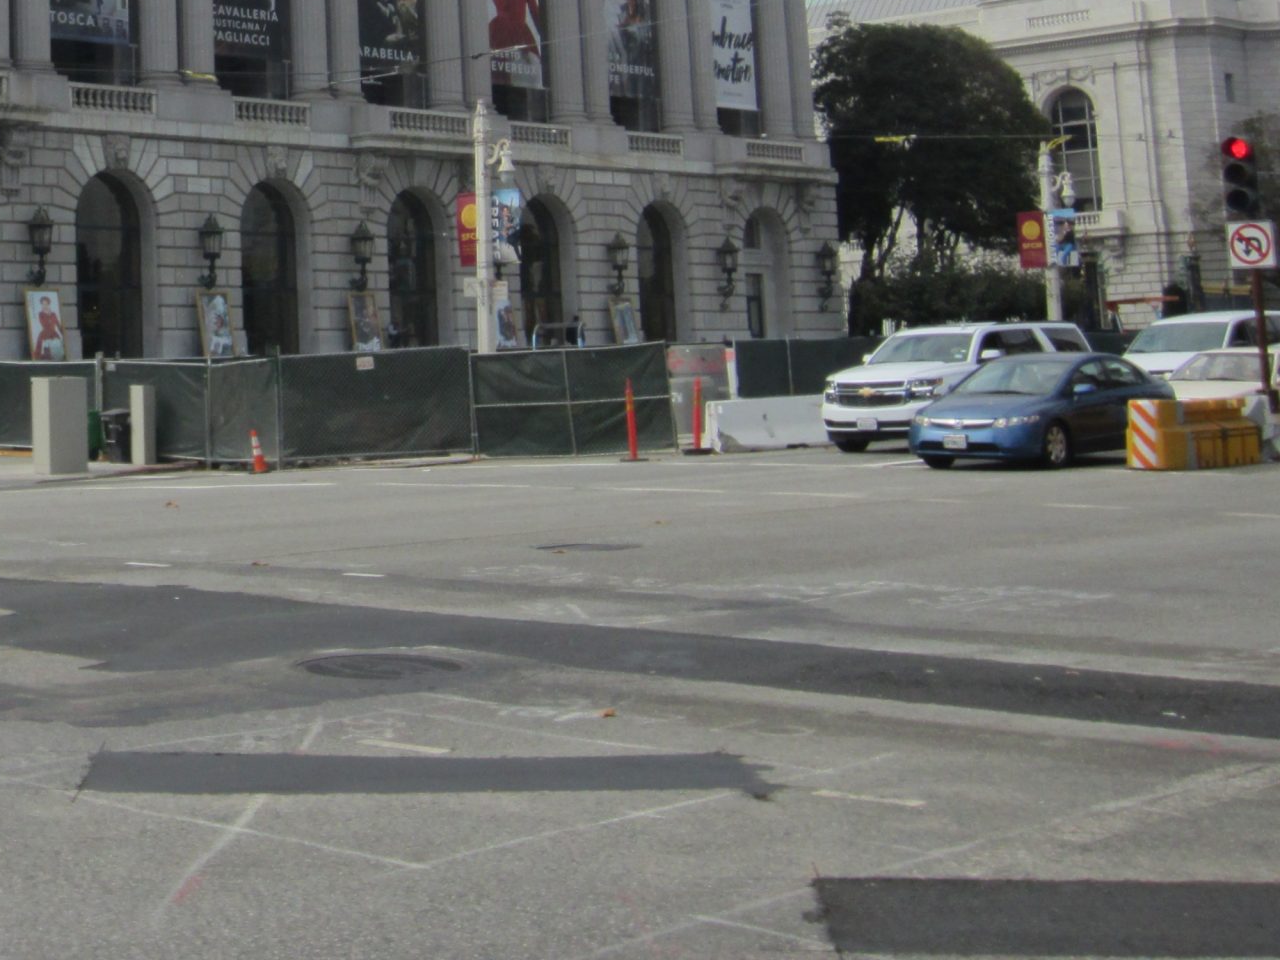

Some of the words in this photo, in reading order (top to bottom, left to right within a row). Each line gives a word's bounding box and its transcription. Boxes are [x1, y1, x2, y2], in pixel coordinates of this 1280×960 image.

[49, 9, 96, 27] TOSCA
[711, 15, 754, 52] mbrace
[491, 60, 536, 74] EVEREUX
[609, 63, 655, 77] ONDERFUL
